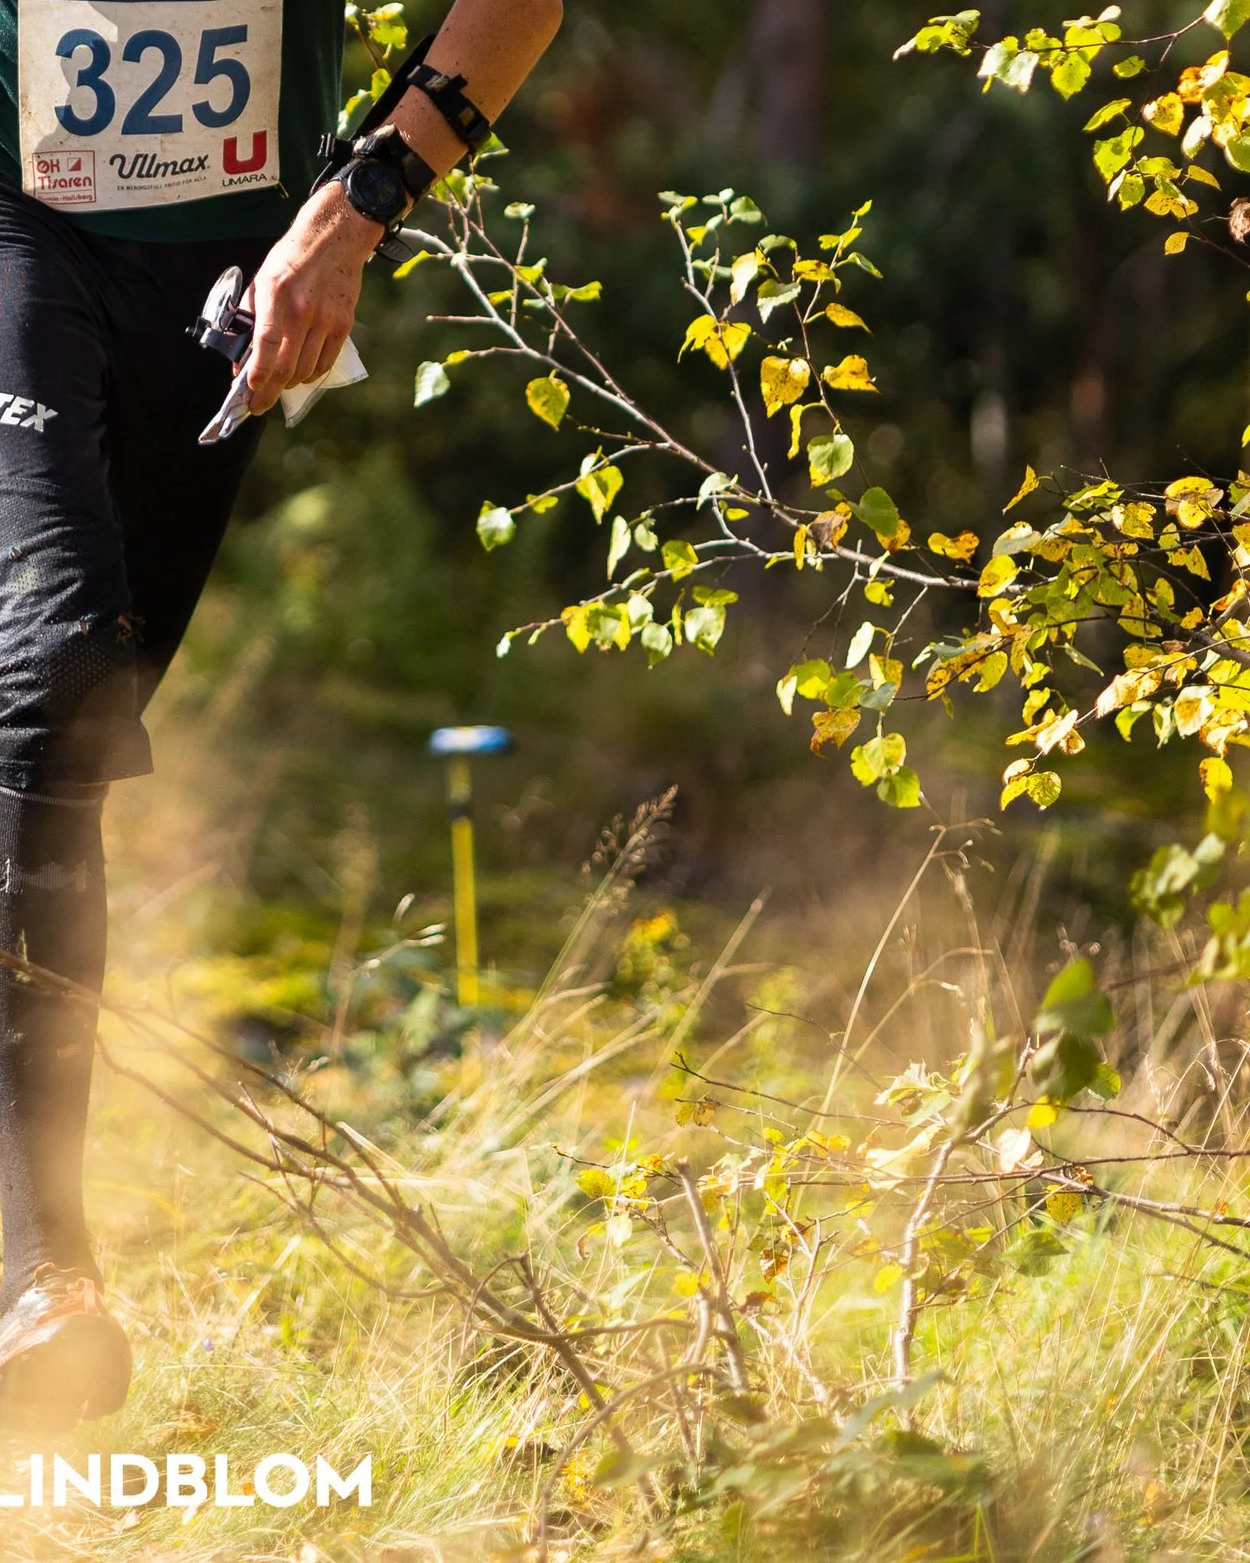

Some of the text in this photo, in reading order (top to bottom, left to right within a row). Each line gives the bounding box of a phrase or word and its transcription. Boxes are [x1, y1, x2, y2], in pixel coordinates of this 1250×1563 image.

[54, 24, 251, 137] 325
[109, 153, 209, 179] Ullmax
[38, 176, 92, 189] Tisaren
[222, 173, 267, 187] UMARA
